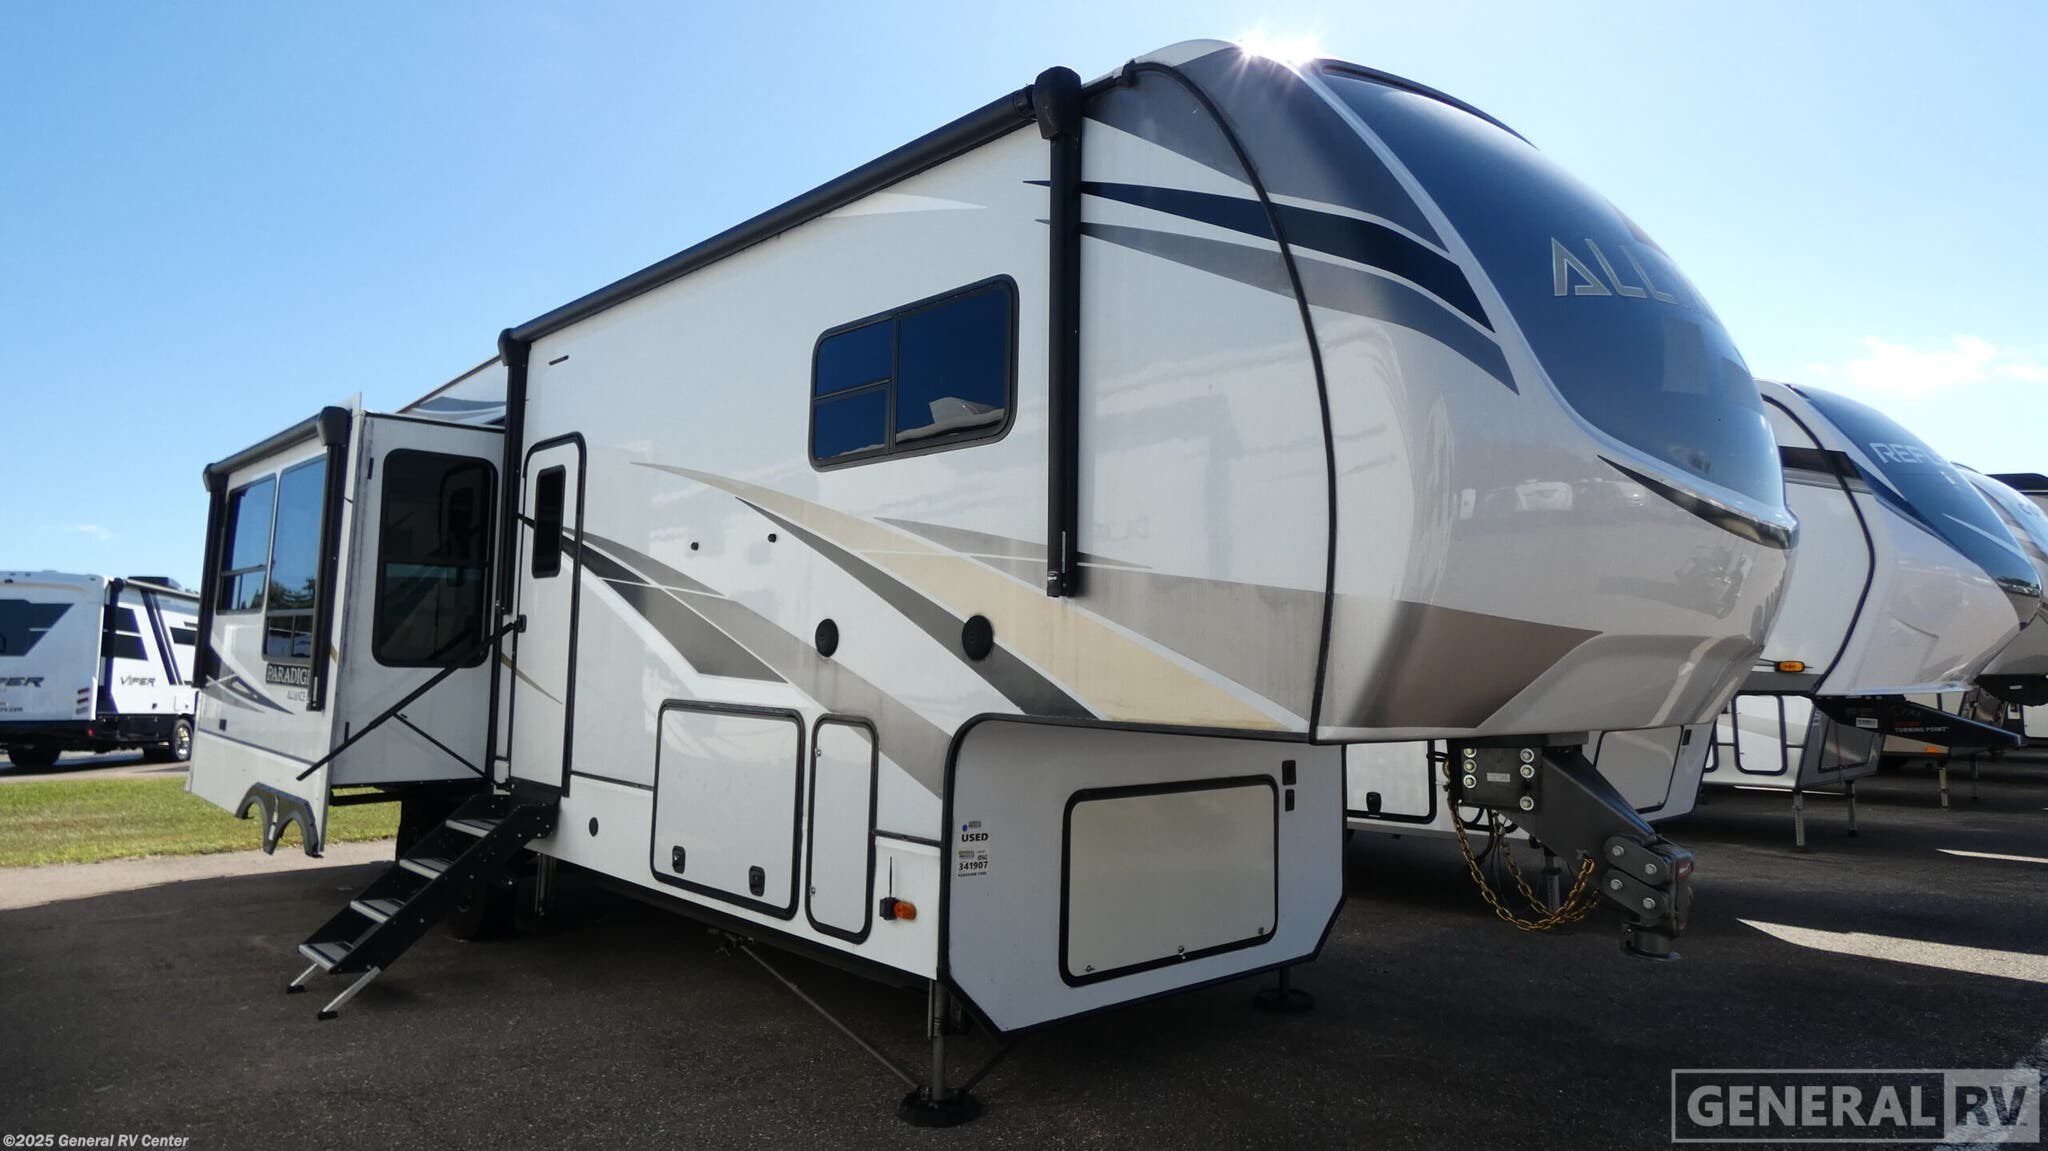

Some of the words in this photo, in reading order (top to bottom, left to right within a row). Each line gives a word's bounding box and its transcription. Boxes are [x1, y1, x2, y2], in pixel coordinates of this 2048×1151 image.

[1551, 236, 1678, 305] ALL
[120, 675, 156, 688] VIPER
[961, 833, 989, 842] USED
[958, 861, 989, 871] 341907
